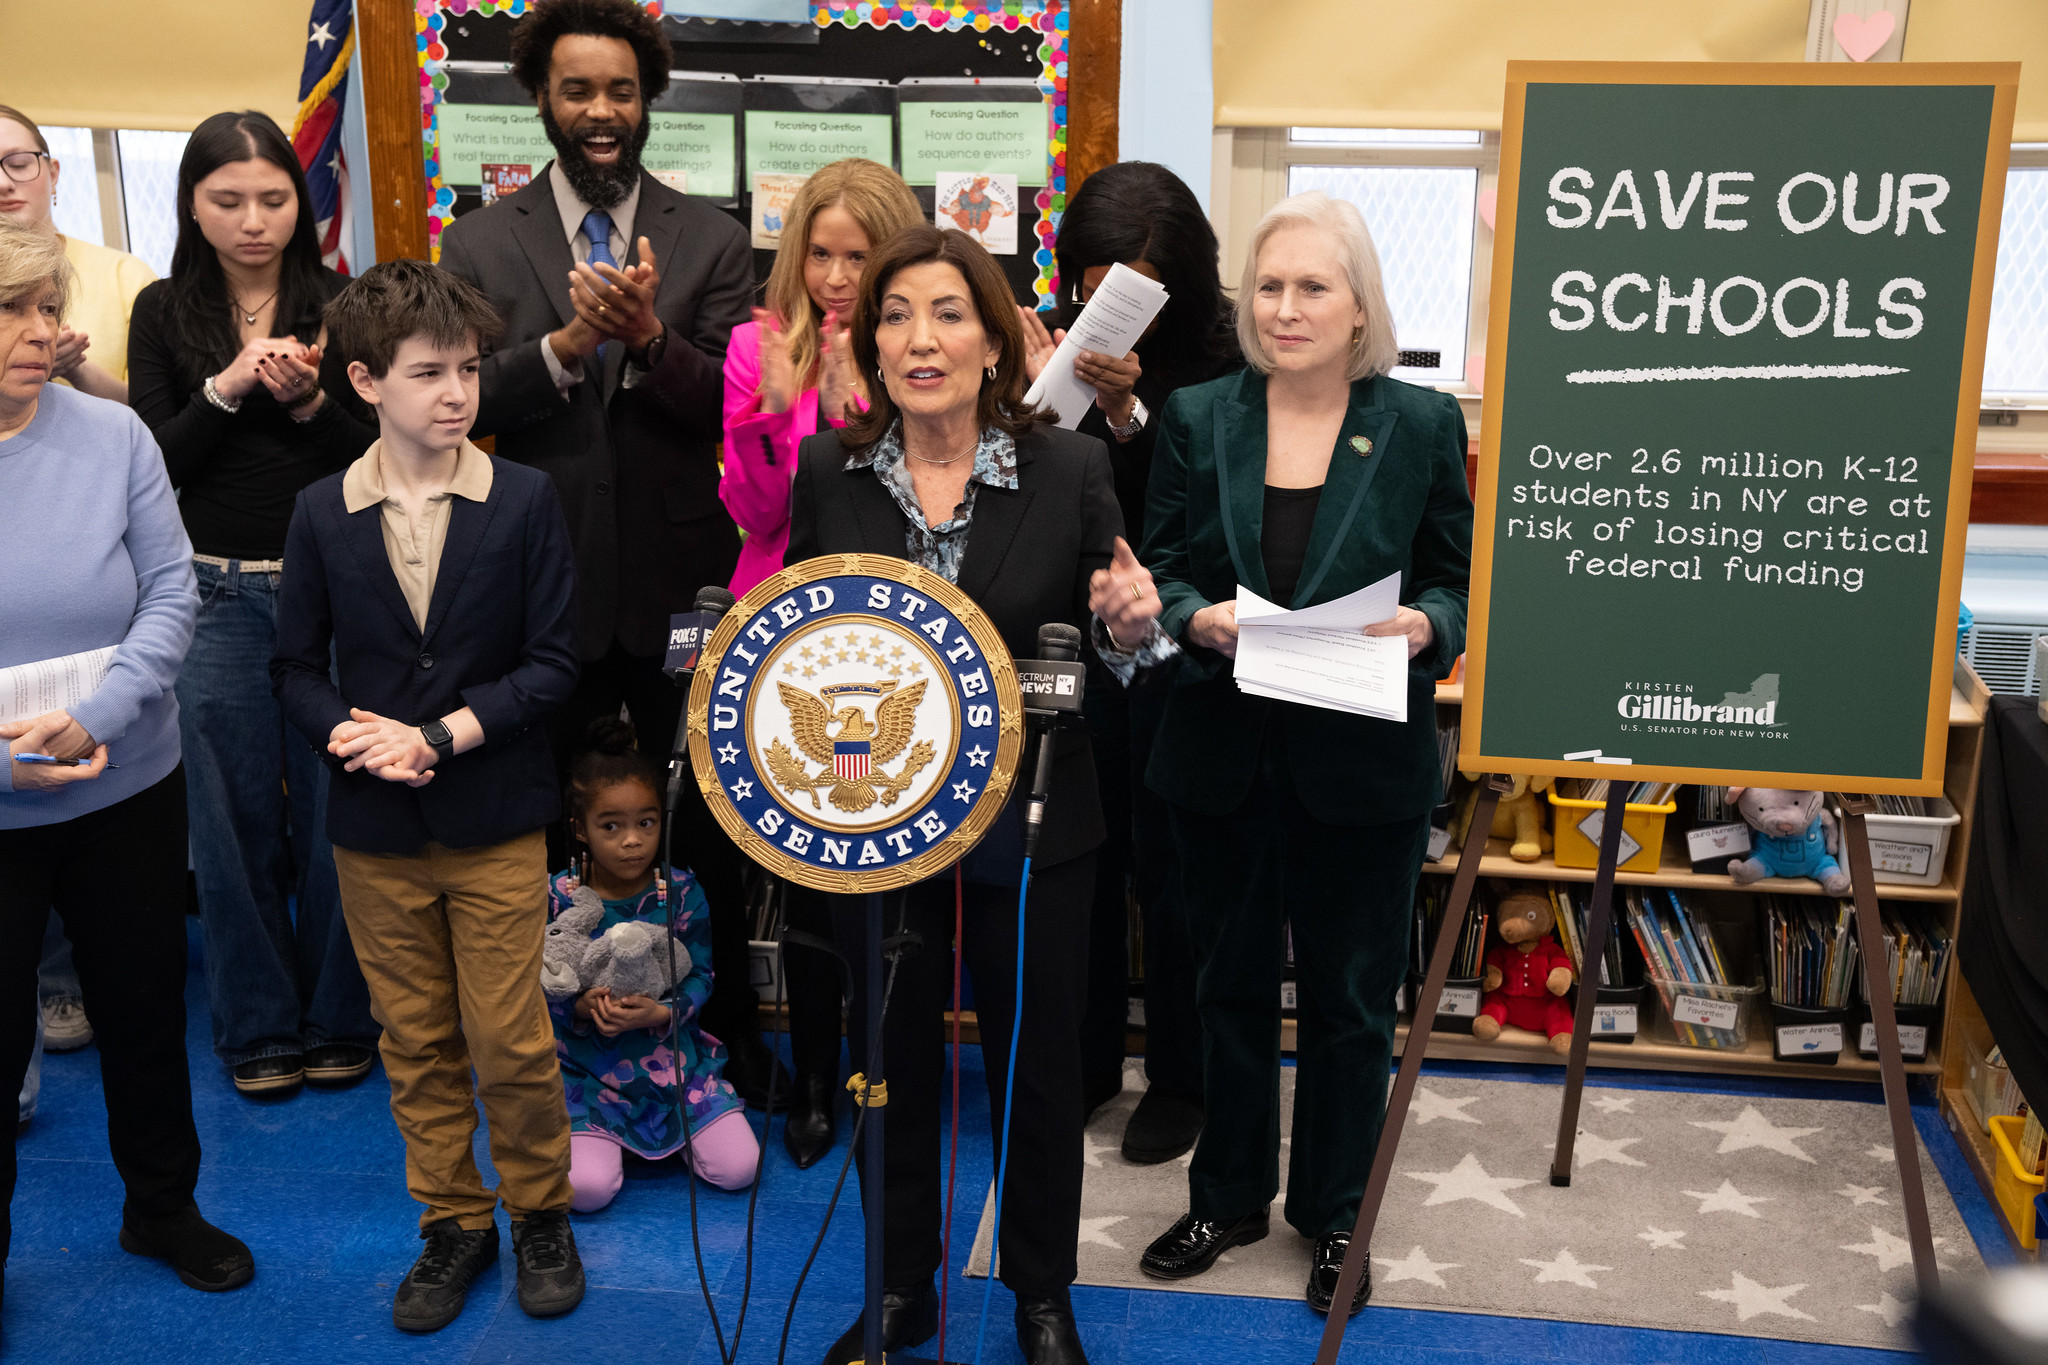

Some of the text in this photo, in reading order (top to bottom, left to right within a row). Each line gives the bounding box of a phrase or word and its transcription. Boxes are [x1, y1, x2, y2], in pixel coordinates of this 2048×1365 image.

[465, 113, 544, 124] Focusing Questi
[930, 110, 1019, 120] Focusing Question
[663, 121, 705, 131] Question
[775, 121, 862, 132] Focusing Question
[453, 133, 486, 144] What
[490, 134, 500, 144] is
[502, 135, 527, 145] true
[925, 130, 1024, 141] How do authors
[663, 142, 711, 153] authors
[769, 142, 868, 155] How do authors
[453, 152, 477, 161] real
[480, 151, 511, 162] farm
[918, 149, 1032, 161] sequence events?
[657, 160, 712, 174] settings?
[760, 160, 800, 170] create
[498, 172, 530, 187] FARM
[1546, 166, 1951, 236] SAVE OUR
[1548, 270, 1927, 340] SCHOOLS
[1529, 444, 1919, 483] Over 2.6 million K-12
[1512, 479, 1931, 518] students in NY are at
[1508, 515, 1929, 554] risk of losing critical
[1566, 550, 1864, 593] federal funding
[714, 584, 993, 731] UNITED STATES
[1019, 673, 1054, 682] ECTRUM
[1067, 685, 1072, 693] 1
[1625, 681, 1694, 693] KIRSTEN
[1617, 694, 1776, 725] Gillibrand
[1621, 724, 1789, 740] U.S. SENATOR FOR NEW YORK
[757, 808, 947, 866] SENATE
[1689, 830, 1711, 840] Laura
[1874, 842, 1924, 854] Weather and
[1881, 851, 1913, 861] Seasons
[1446, 991, 1474, 1000] Animals
[1683, 997, 1699, 1006] Miss
[1687, 1006, 1724, 1018] Favorites
[1782, 1025, 1840, 1036] Water Animals
